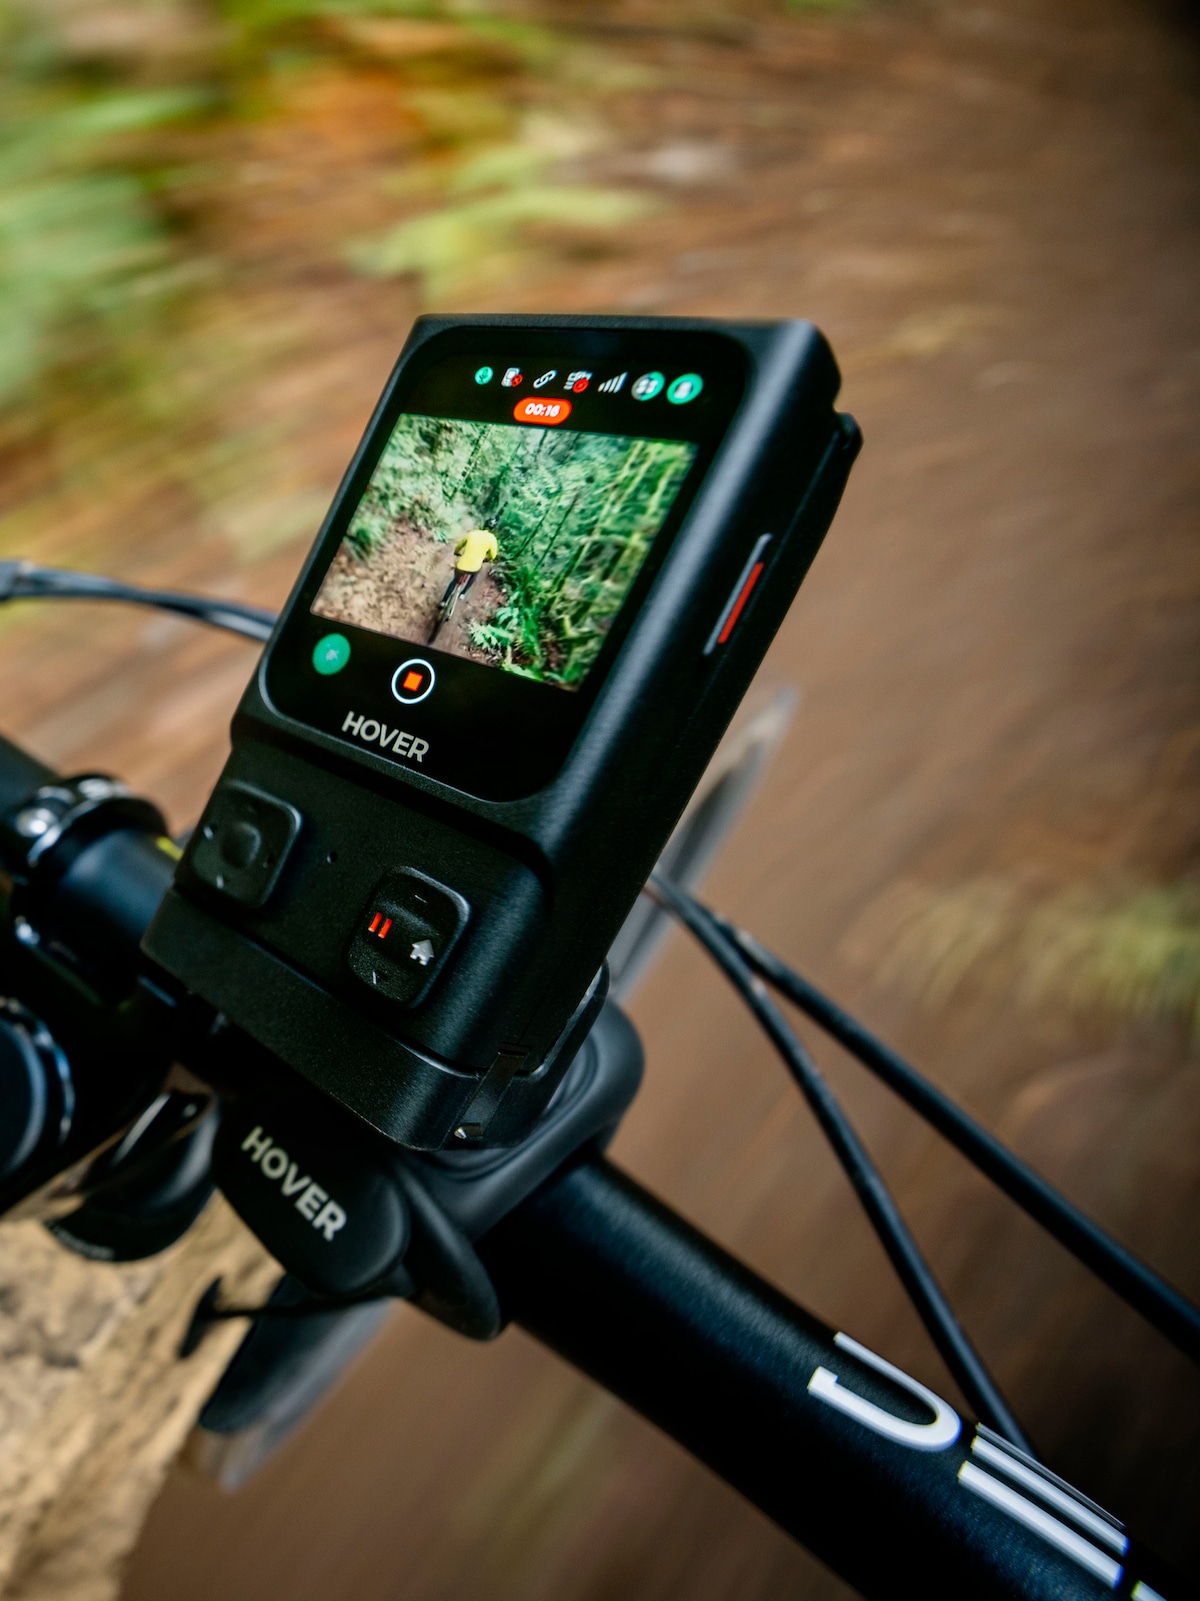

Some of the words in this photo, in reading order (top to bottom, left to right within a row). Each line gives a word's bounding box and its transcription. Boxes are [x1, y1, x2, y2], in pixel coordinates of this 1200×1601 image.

[525, 403, 560, 417] 00:16
[341, 710, 430, 763] HOVER
[240, 1125, 347, 1242] HOVER
